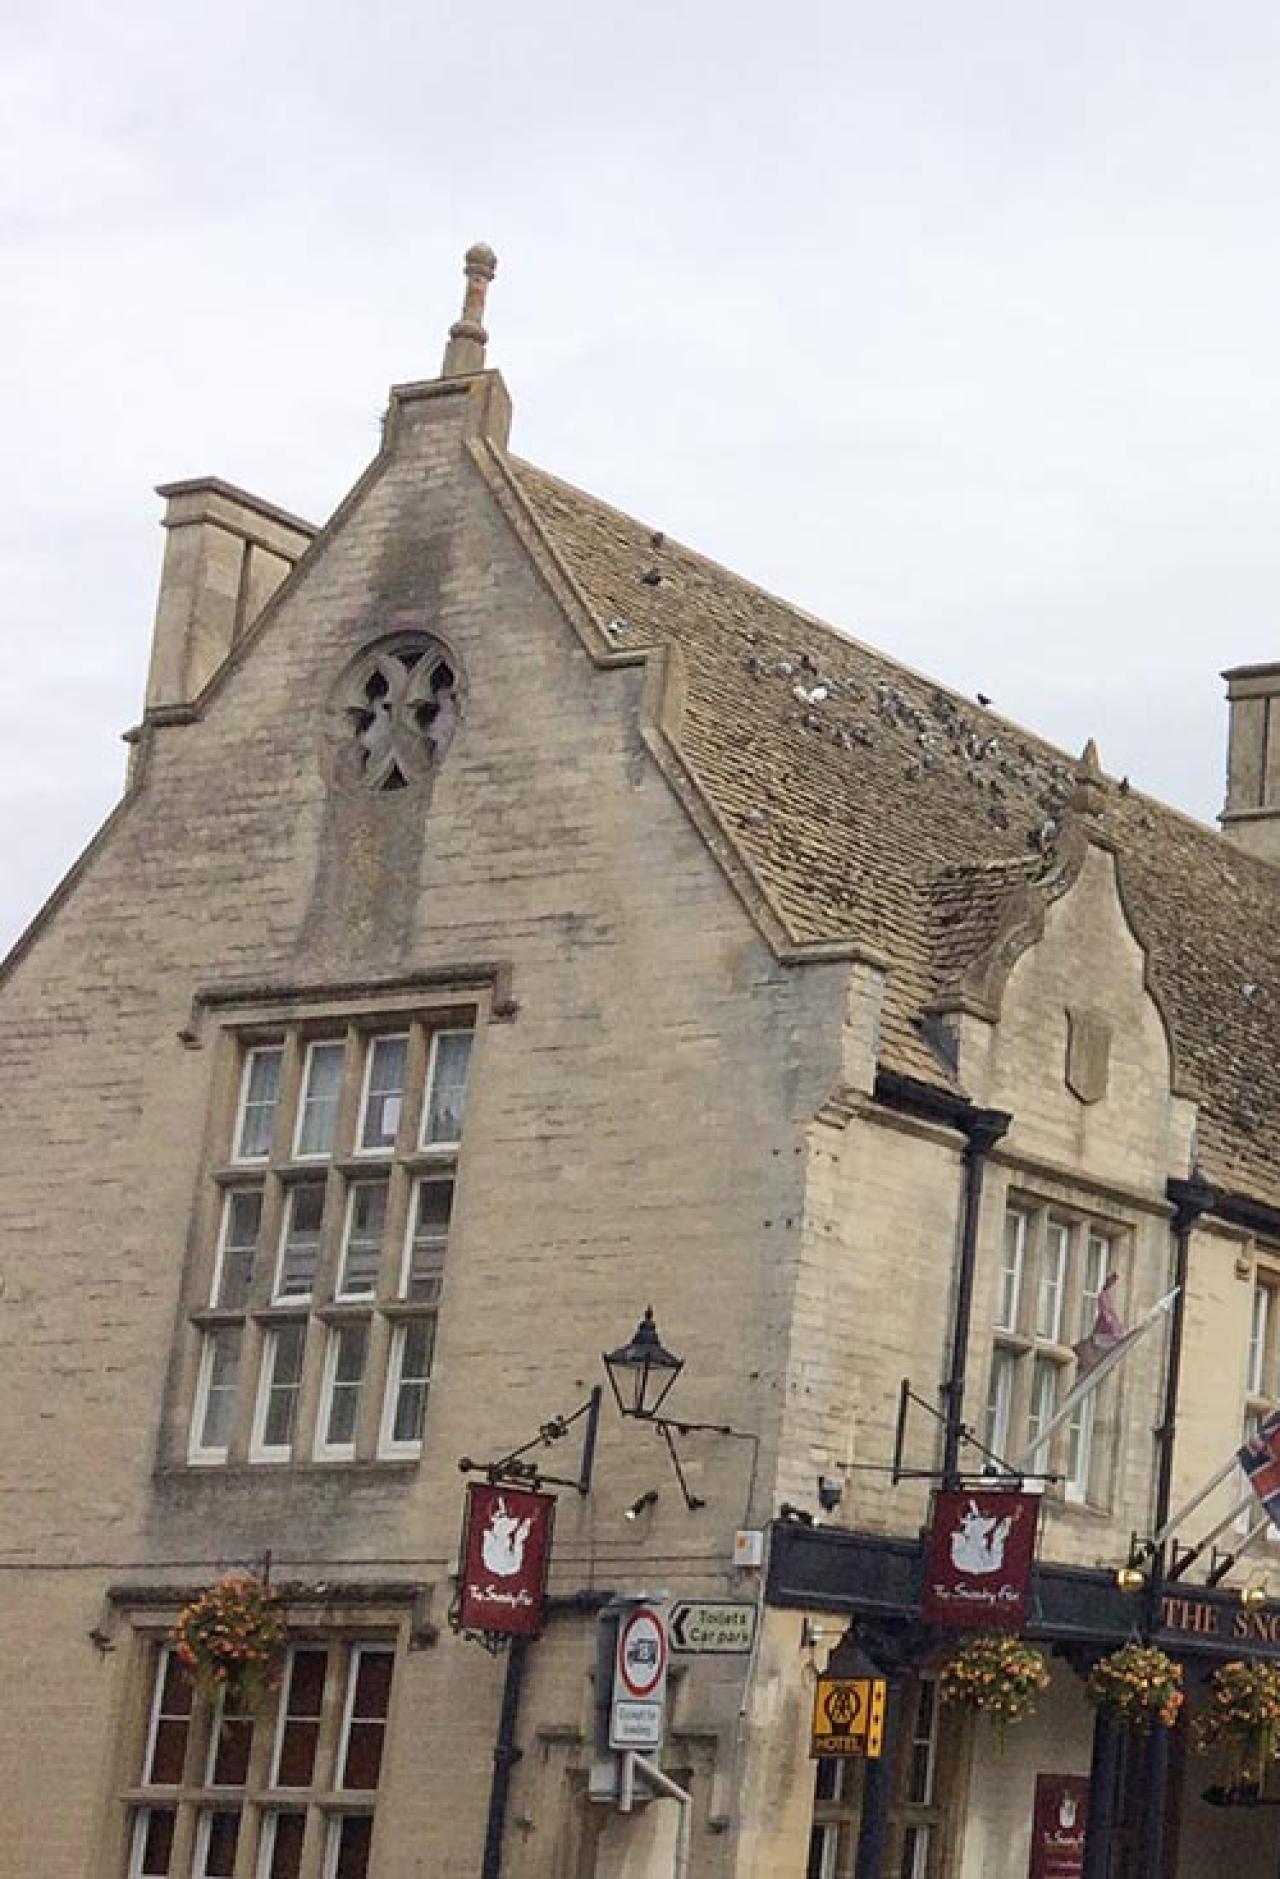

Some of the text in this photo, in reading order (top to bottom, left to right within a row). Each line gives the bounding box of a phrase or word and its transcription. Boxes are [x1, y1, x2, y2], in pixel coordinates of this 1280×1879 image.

[954, 1582, 997, 1605] Snooty
[700, 1610, 747, 1624] Toilets
[1161, 1597, 1220, 1633] THE
[690, 1627, 748, 1645] Car park
[815, 1736, 863, 1753] HOTEL
